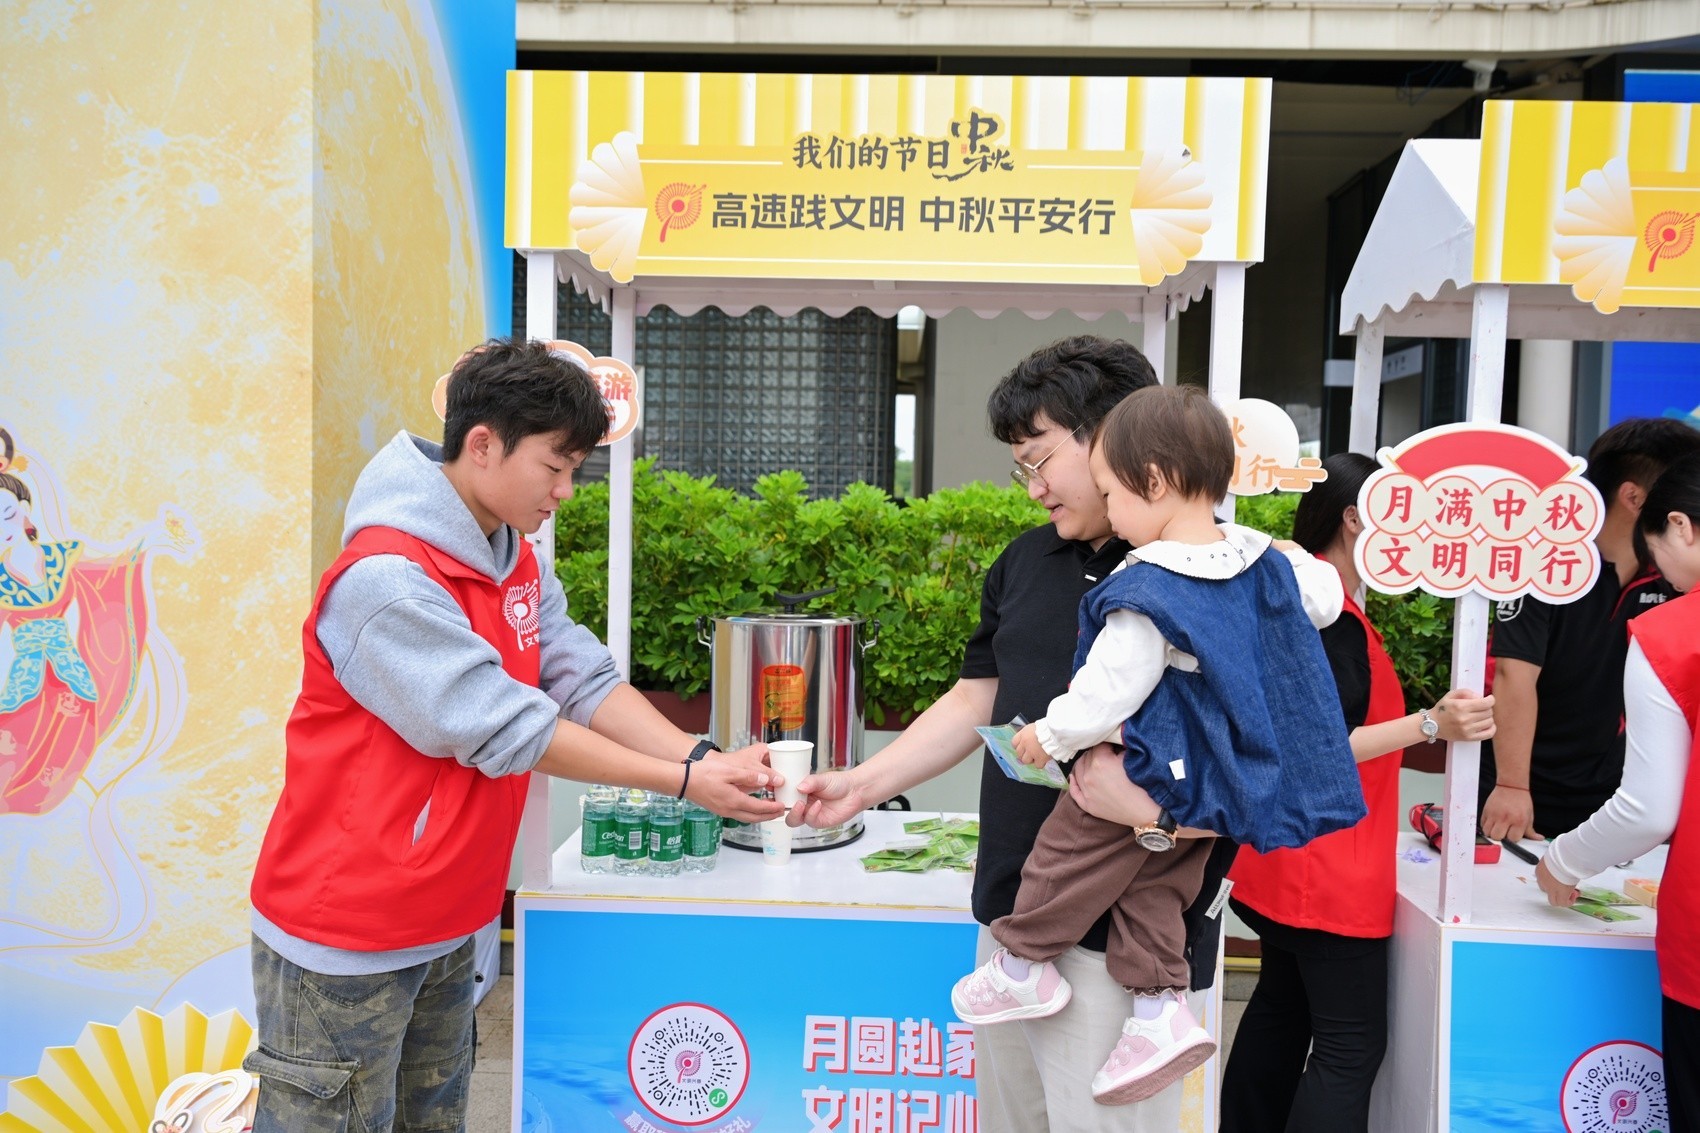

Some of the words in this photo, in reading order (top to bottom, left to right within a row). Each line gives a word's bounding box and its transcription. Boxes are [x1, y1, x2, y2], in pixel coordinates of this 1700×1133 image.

[792, 134, 949, 172] 我们的节日
[932, 111, 1014, 181] 中秋
[712, 192, 904, 231] 高速践文明
[919, 196, 1115, 235] 中秋平安行
[1381, 485, 1586, 531] 月满中秋
[1376, 537, 1581, 586] 文明同行
